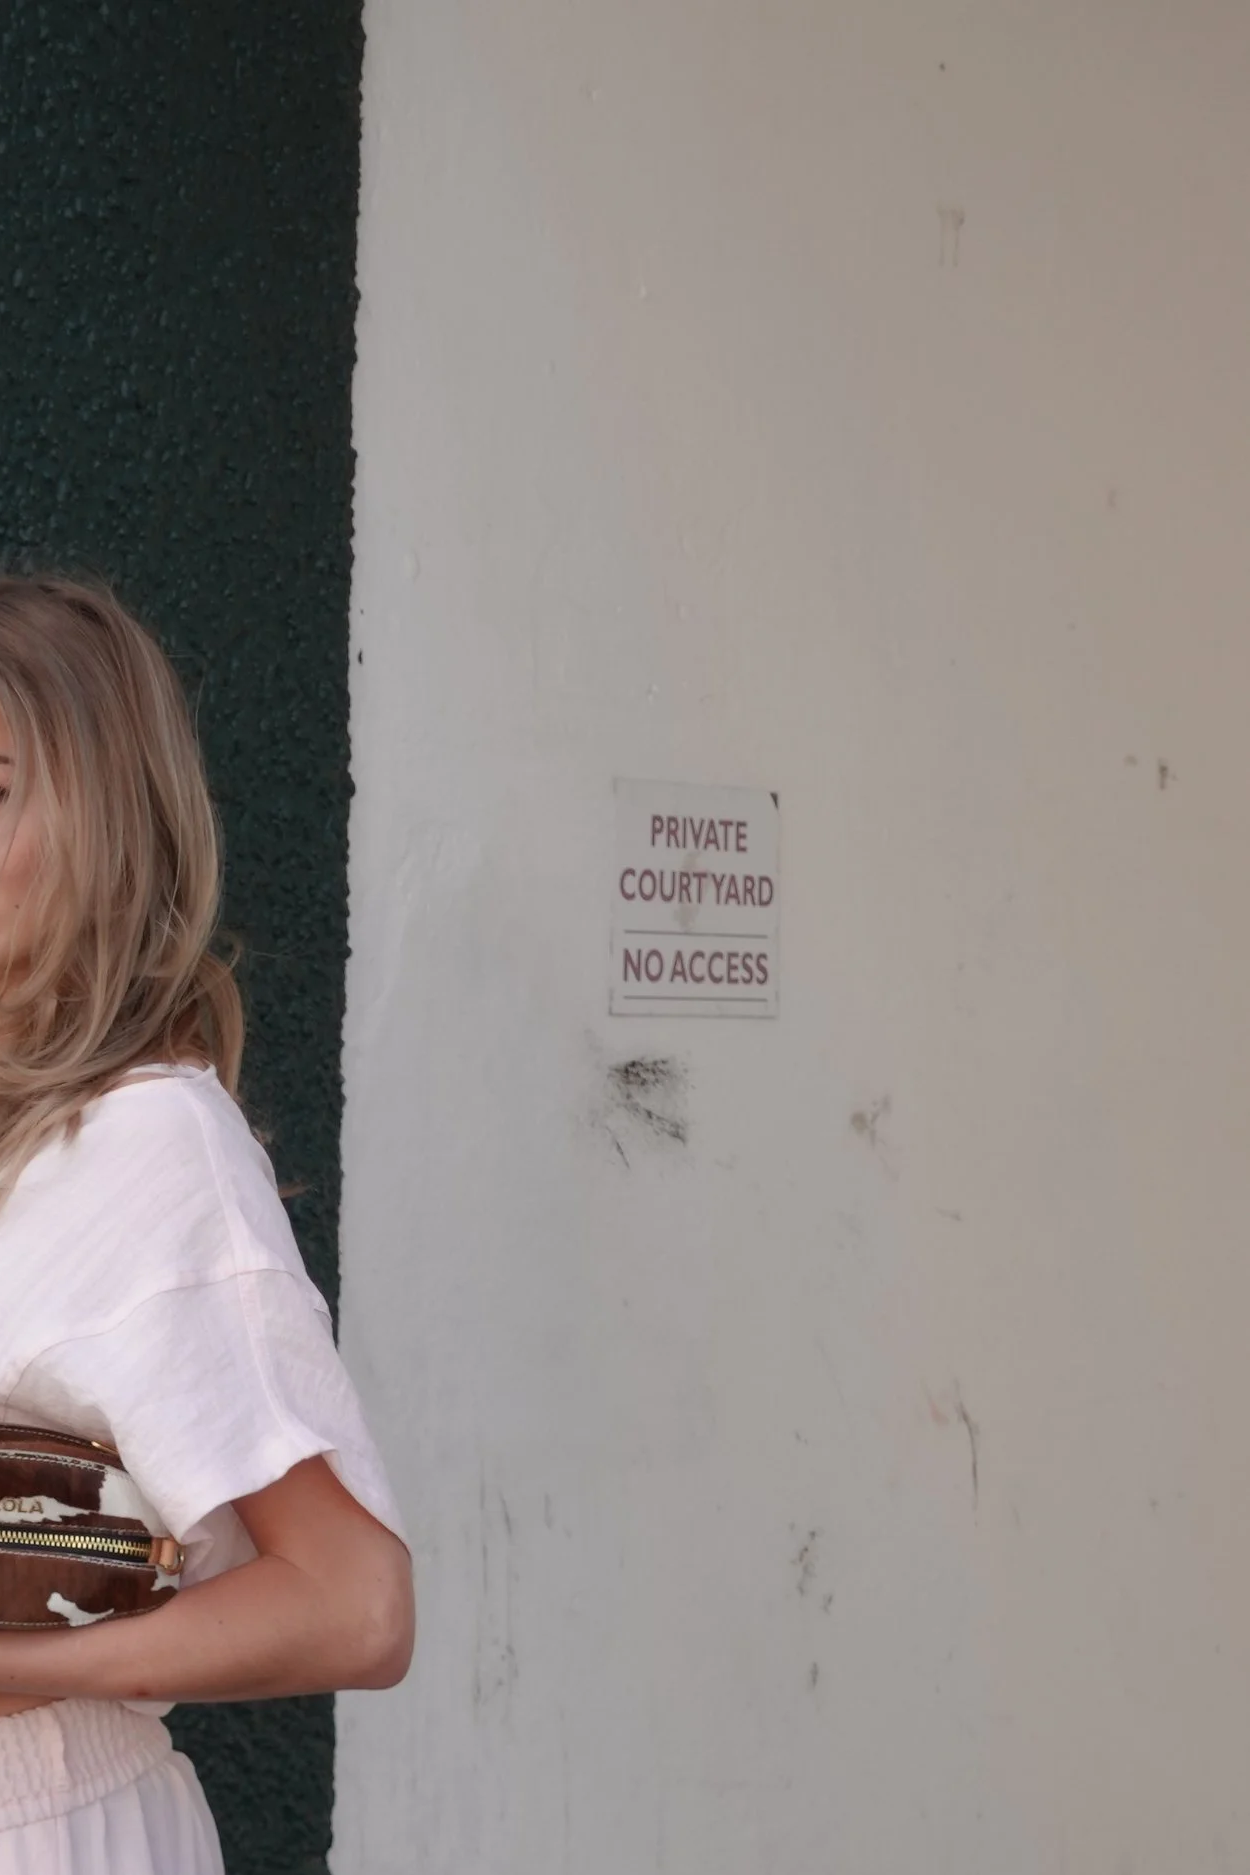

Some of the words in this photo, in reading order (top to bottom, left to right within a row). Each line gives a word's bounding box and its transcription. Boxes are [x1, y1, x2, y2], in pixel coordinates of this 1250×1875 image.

[651, 814, 748, 853] PRIVATE
[619, 867, 775, 907] COURTYARD
[622, 948, 664, 983] NO
[669, 949, 769, 985] ACCESS
